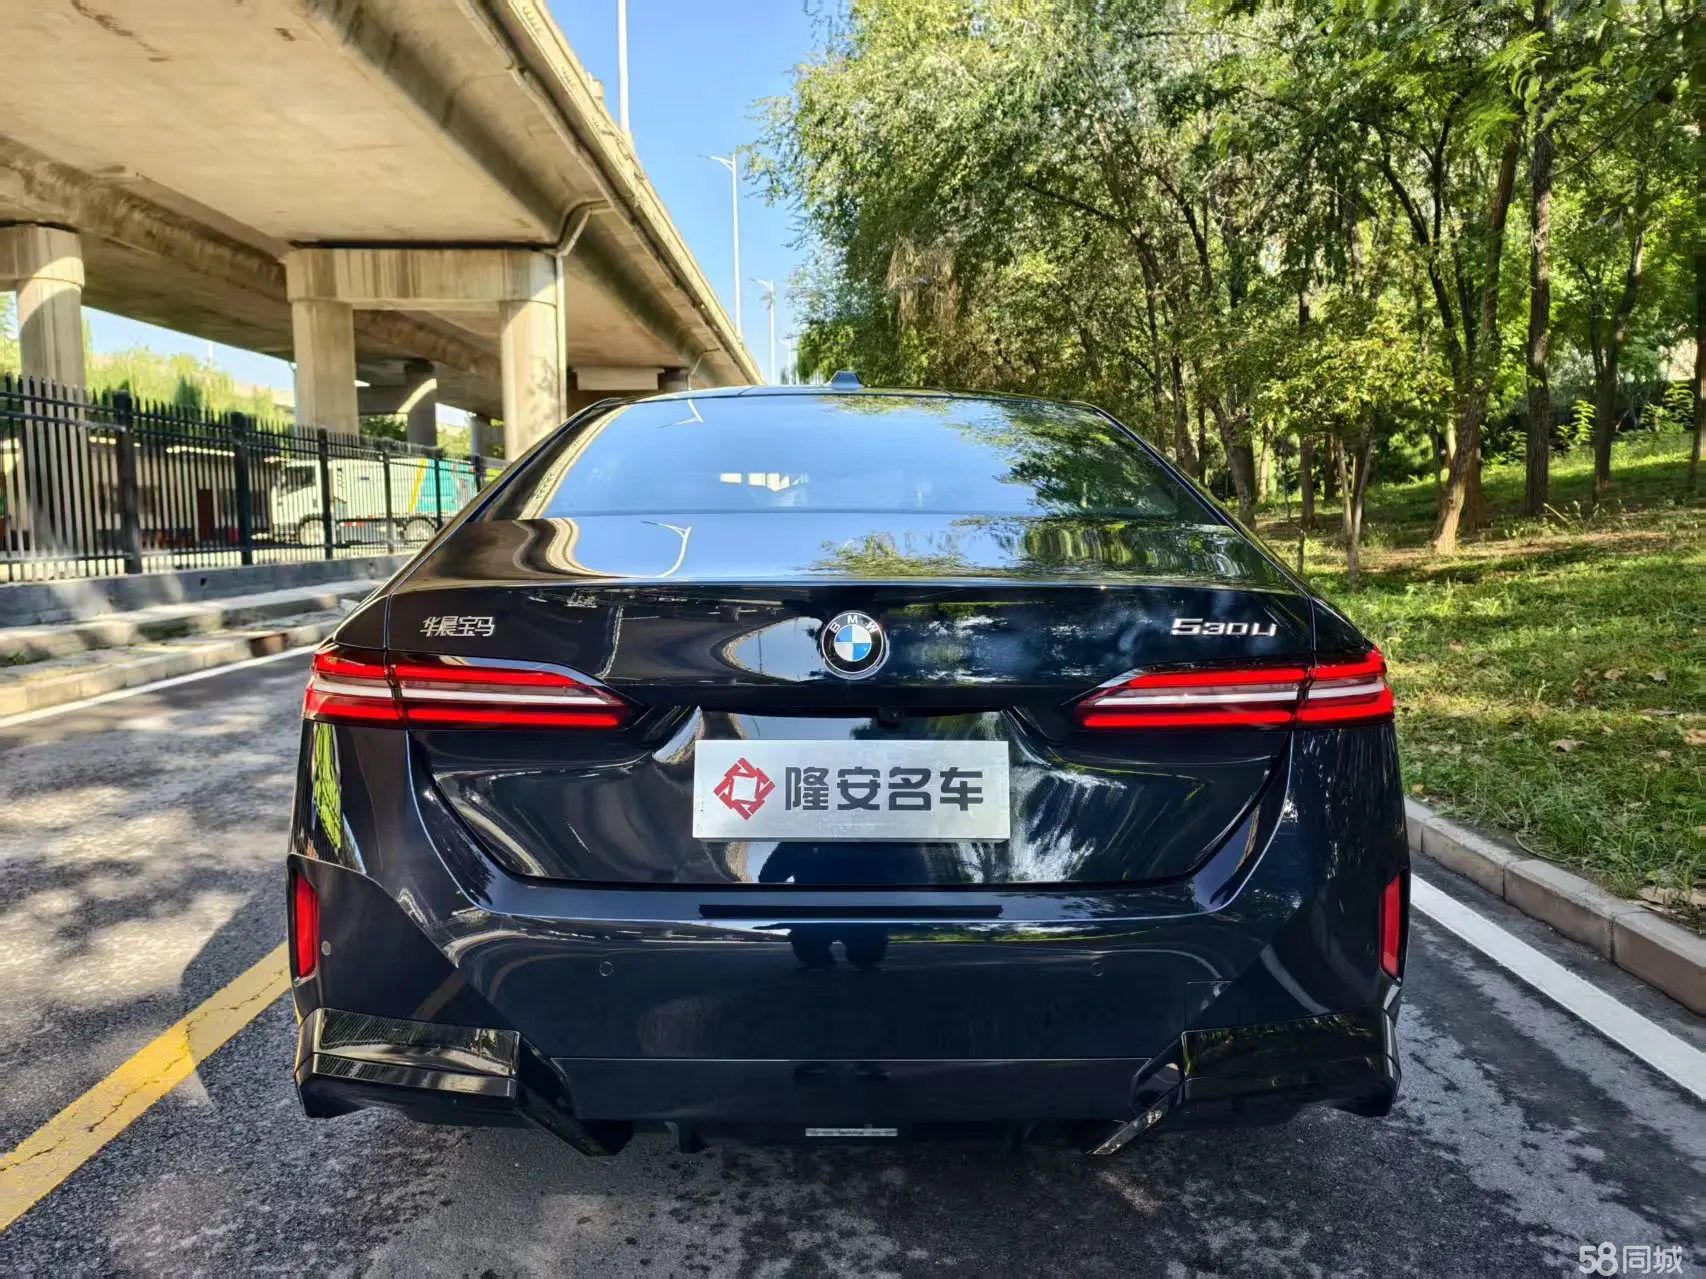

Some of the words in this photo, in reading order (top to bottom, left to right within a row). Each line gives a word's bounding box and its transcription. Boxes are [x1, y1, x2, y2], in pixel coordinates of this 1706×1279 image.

[420, 615, 495, 637] 华晨宝马
[829, 614, 878, 634] BMW
[785, 766, 984, 812] 隆安名车
